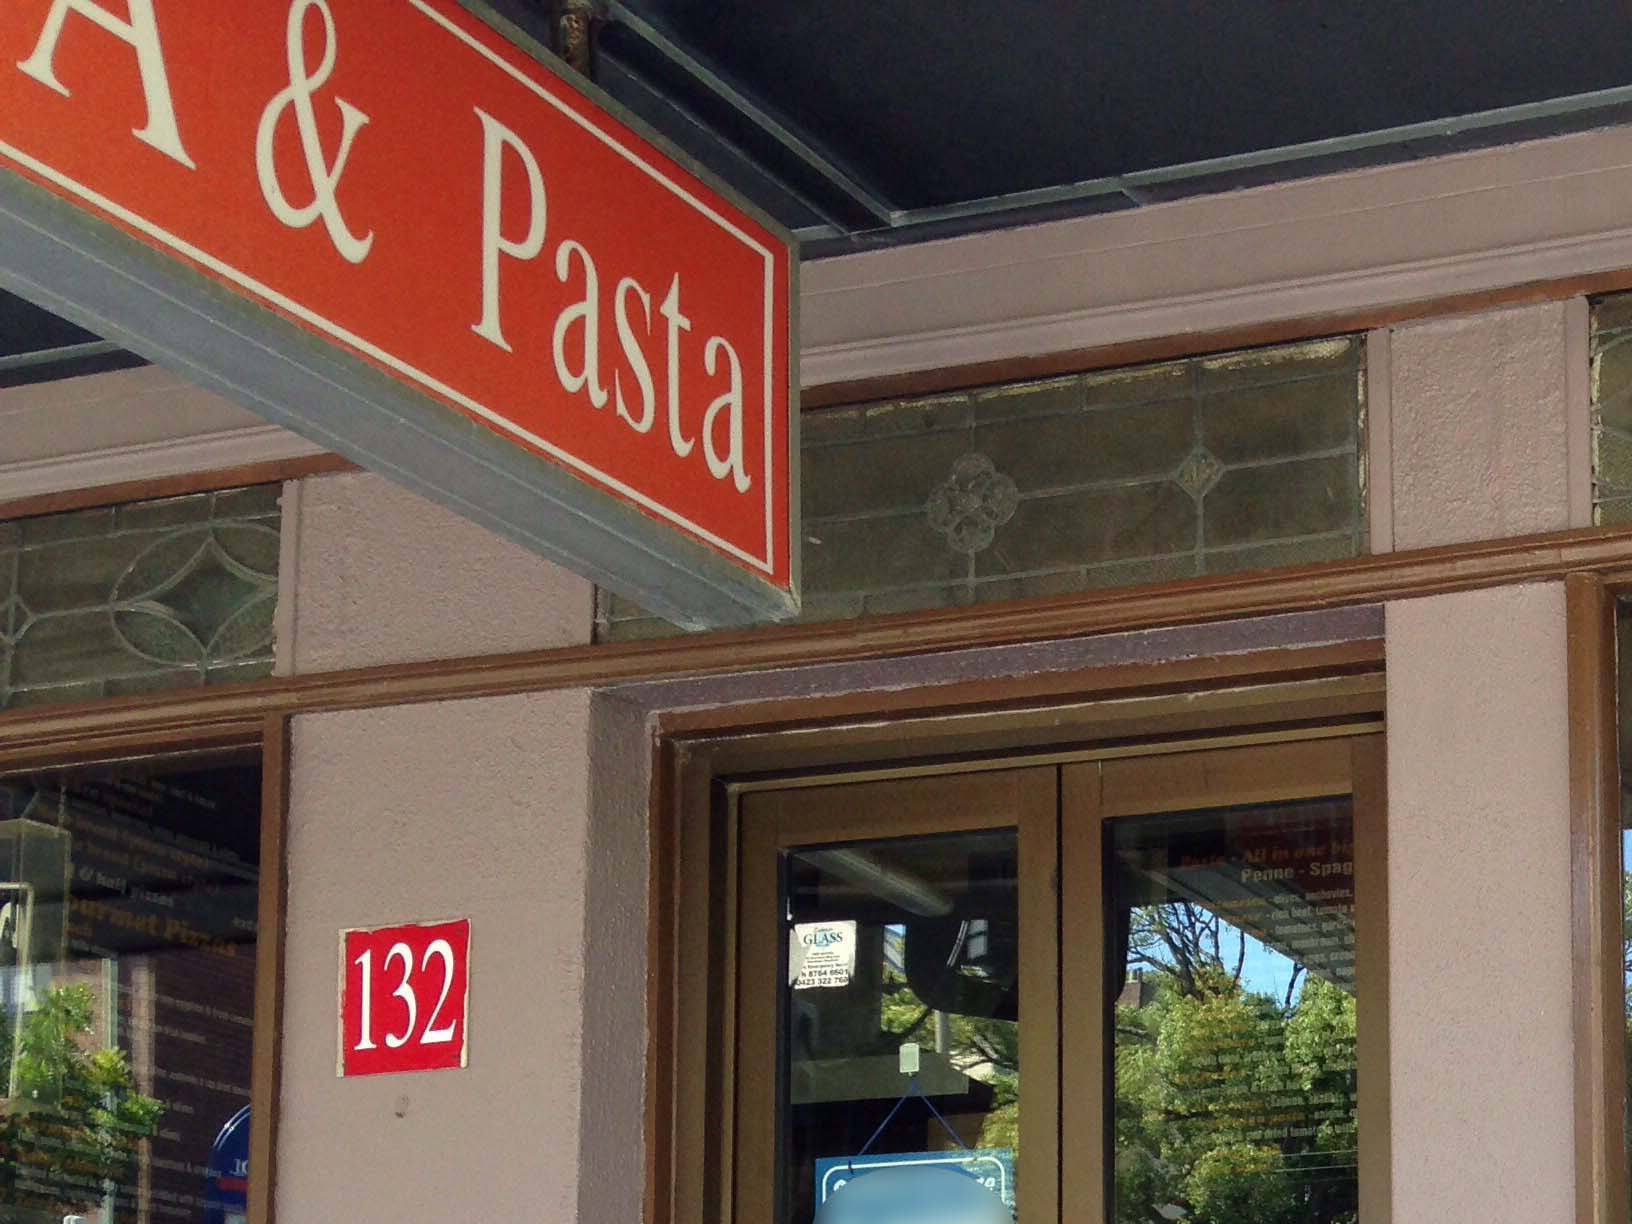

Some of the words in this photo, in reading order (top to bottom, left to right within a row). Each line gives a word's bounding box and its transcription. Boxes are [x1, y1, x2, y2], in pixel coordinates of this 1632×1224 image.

[255, 0, 374, 264] &
[470, 105, 751, 494] Pasta
[354, 938, 457, 1051] 132
[803, 932, 843, 945] GLASS
